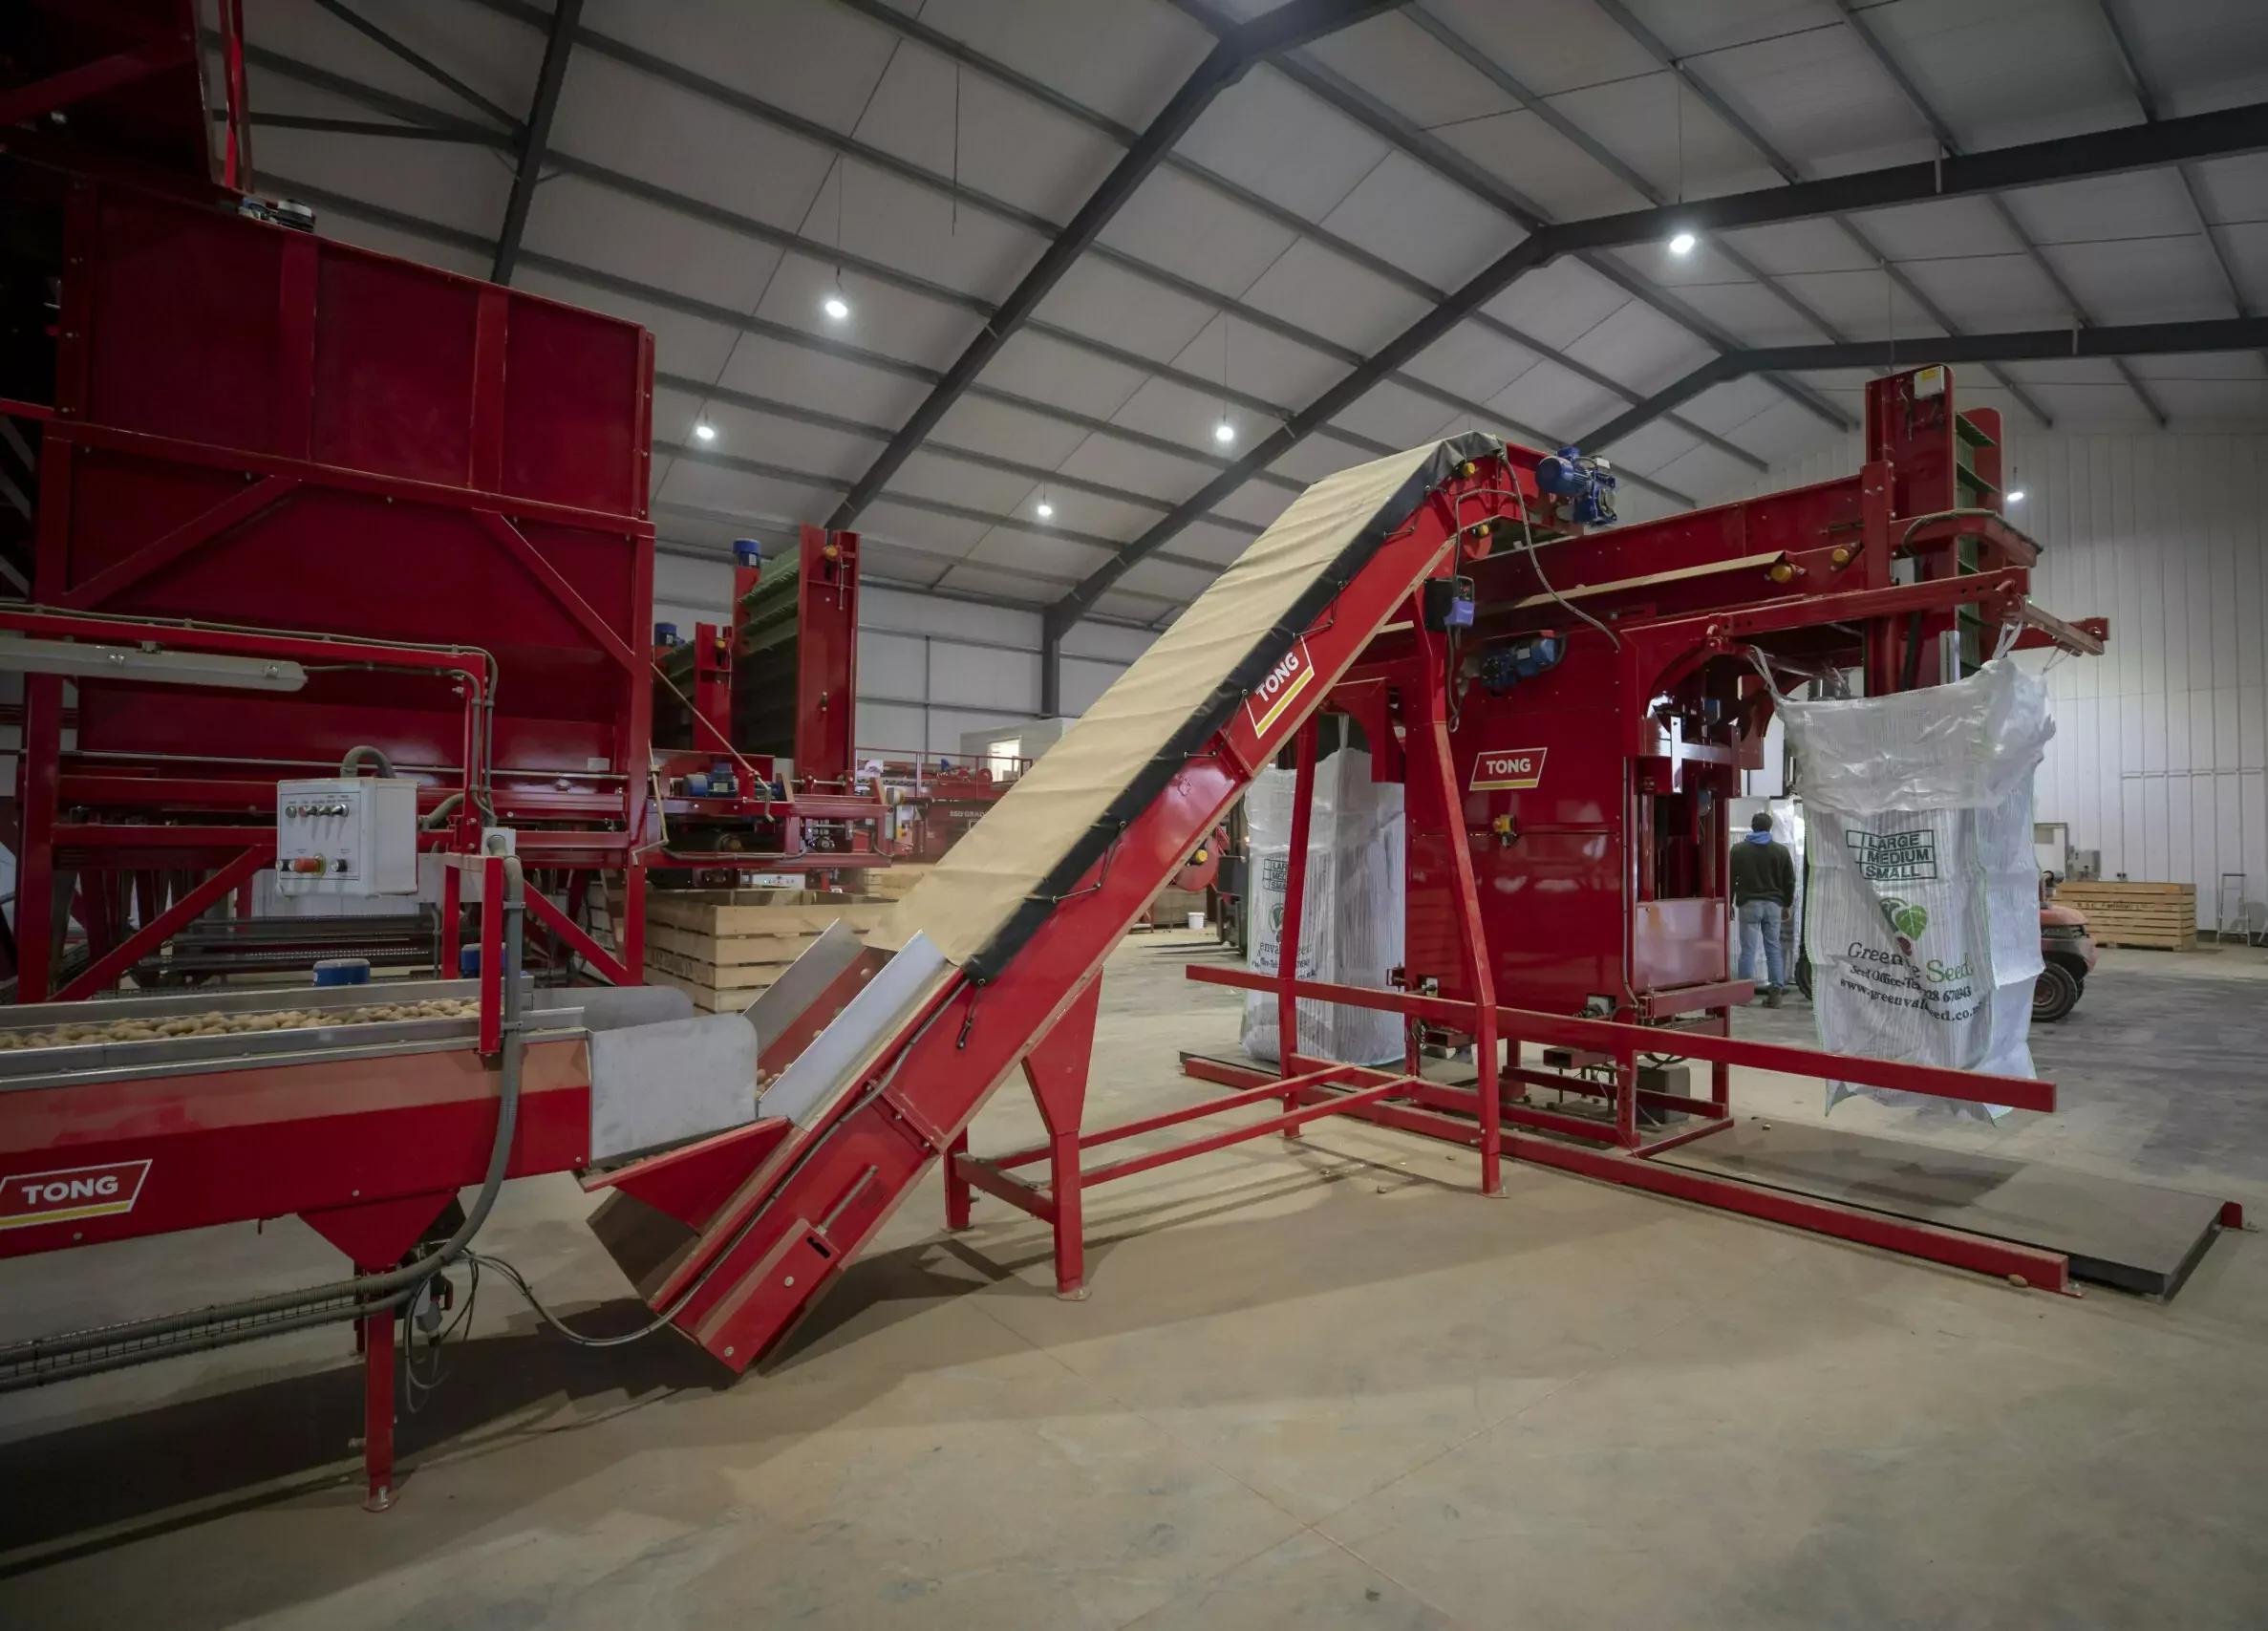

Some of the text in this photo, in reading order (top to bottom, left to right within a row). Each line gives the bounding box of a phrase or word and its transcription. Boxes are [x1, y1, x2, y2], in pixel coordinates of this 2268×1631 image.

[1255, 652, 1299, 701] TONG
[1487, 758, 1531, 775] TONG
[1869, 834, 1920, 849] LARGE
[1867, 848, 1929, 865] MEDIUM
[1866, 866, 1920, 878] SMALL
[1926, 954, 1974, 984] Seed
[21, 1175, 118, 1205] TONG
